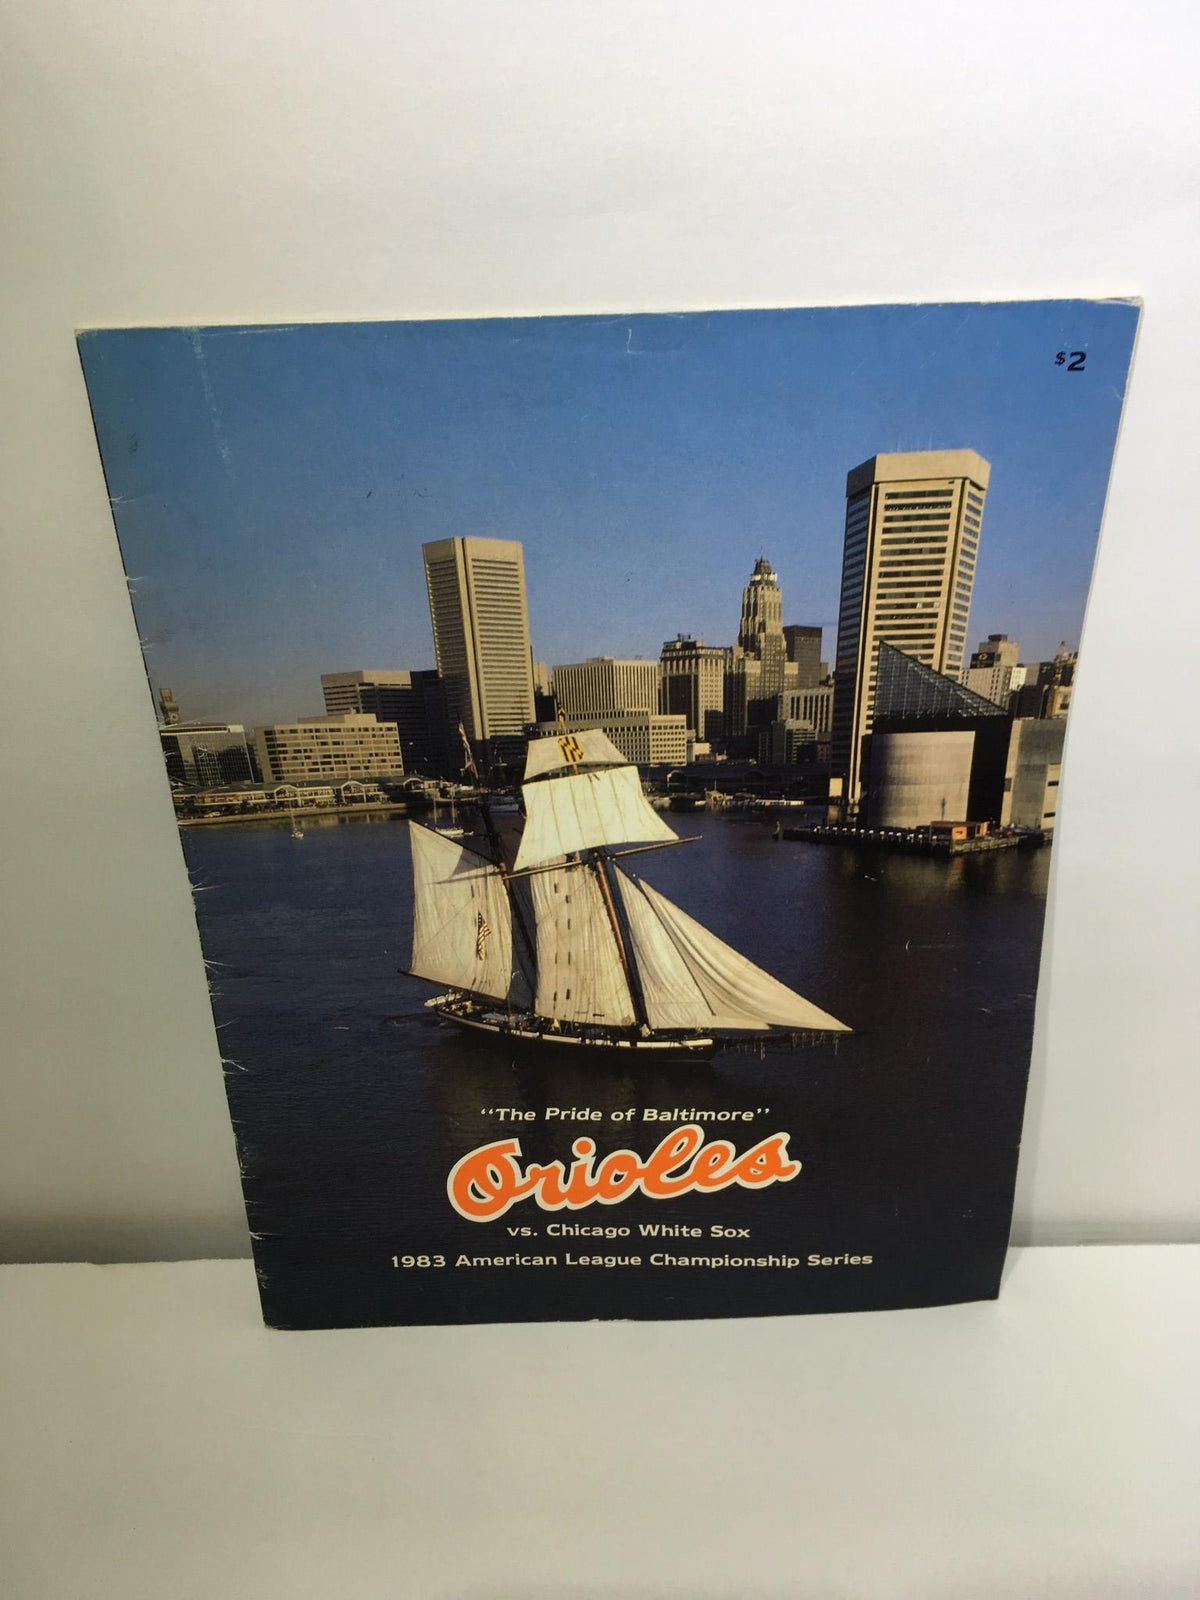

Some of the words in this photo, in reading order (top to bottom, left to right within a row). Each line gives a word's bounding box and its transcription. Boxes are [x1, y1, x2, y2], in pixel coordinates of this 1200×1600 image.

[1054, 351, 1087, 371] $2
[544, 1107, 603, 1121] Pride
[610, 1108, 637, 1121] of
[446, 1123, 803, 1223] Orioles
[506, 1226, 538, 1237] vs.
[546, 1223, 631, 1239] Chicago
[638, 1224, 703, 1238] White
[710, 1225, 751, 1238] Sox
[391, 1254, 446, 1268] 1983
[455, 1253, 558, 1267] American
[565, 1252, 642, 1268] League
[649, 1253, 800, 1269] Championship
[807, 1253, 873, 1267] Series
